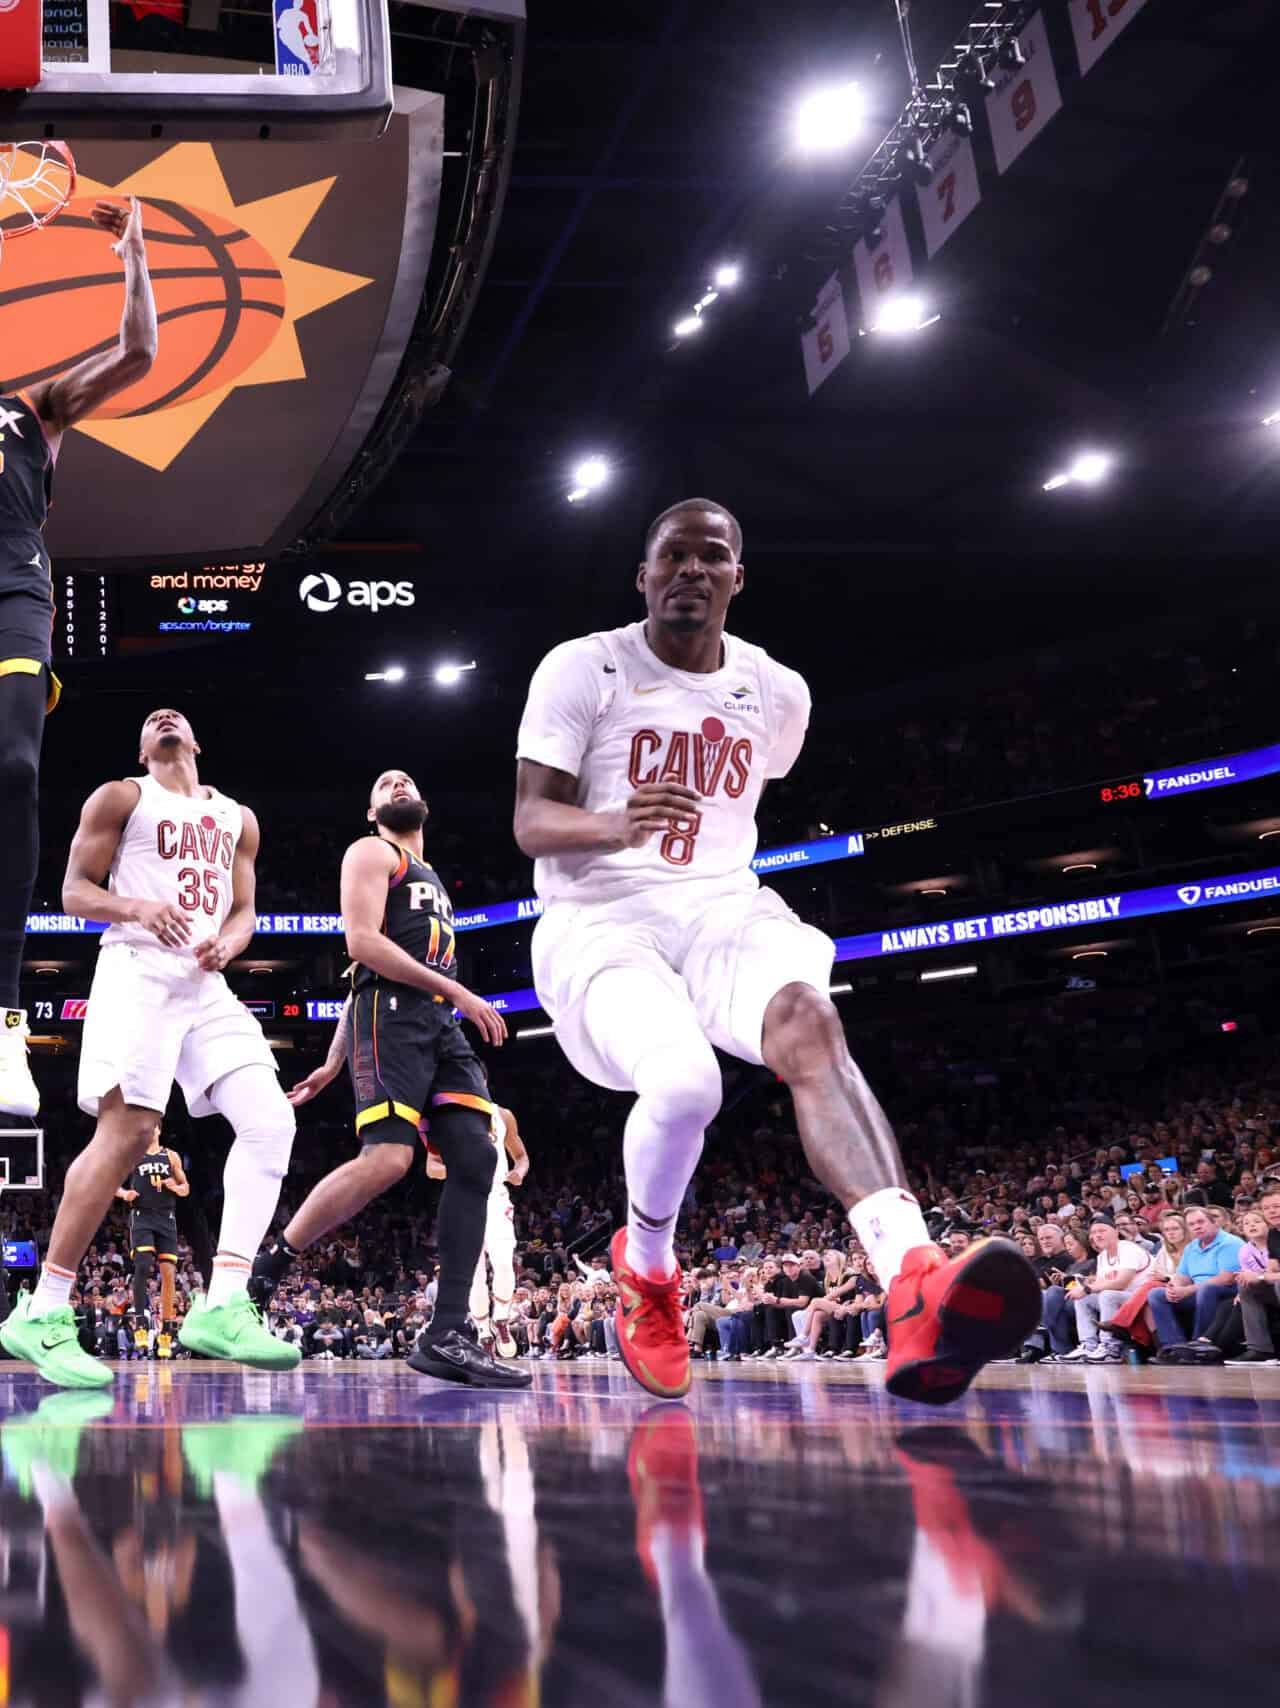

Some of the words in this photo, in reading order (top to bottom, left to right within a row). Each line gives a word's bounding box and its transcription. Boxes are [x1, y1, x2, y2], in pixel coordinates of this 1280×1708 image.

[283, 63, 305, 77] NBA
[65, 575, 74, 585] 2
[99, 575, 105, 585] 1
[150, 571, 188, 589] and
[193, 575, 262, 592] money
[99, 588, 105, 597] 1
[347, 580, 415, 613] aps
[99, 599, 105, 609] 1
[198, 599, 229, 614] aps
[67, 611, 73, 621] 1
[99, 611, 107, 621] 2
[66, 623, 74, 633] 0
[99, 623, 107, 632] 2
[159, 619, 252, 632] aps.com/brighter
[66, 635, 74, 644] 0
[99, 634, 107, 644] 0
[67, 646, 73, 656] 1
[100, 646, 106, 656] 1
[723, 701, 760, 714] CLIFFS
[628, 720, 752, 799] CAVS
[1101, 783, 1141, 802] 8:36
[1157, 767, 1236, 791] FANDUEL
[157, 816, 234, 870] CAVS
[660, 809, 702, 866] 8
[752, 850, 810, 869] FANDUEL
[178, 867, 219, 915] 35
[881, 925, 950, 953] ALWAYS
[953, 918, 988, 941] BET
[991, 897, 1121, 935] RESPONSIBLY
[1205, 876, 1280, 899] FANDUEL
[25, 915, 86, 931] ONSIBLY
[274, 915, 300, 931] BET
[426, 916, 456, 970] 17
[34, 1002, 53, 1019] 73
[283, 1004, 300, 1016] 20
[138, 1163, 170, 1177] PHX
[150, 1174, 163, 1193] 4
